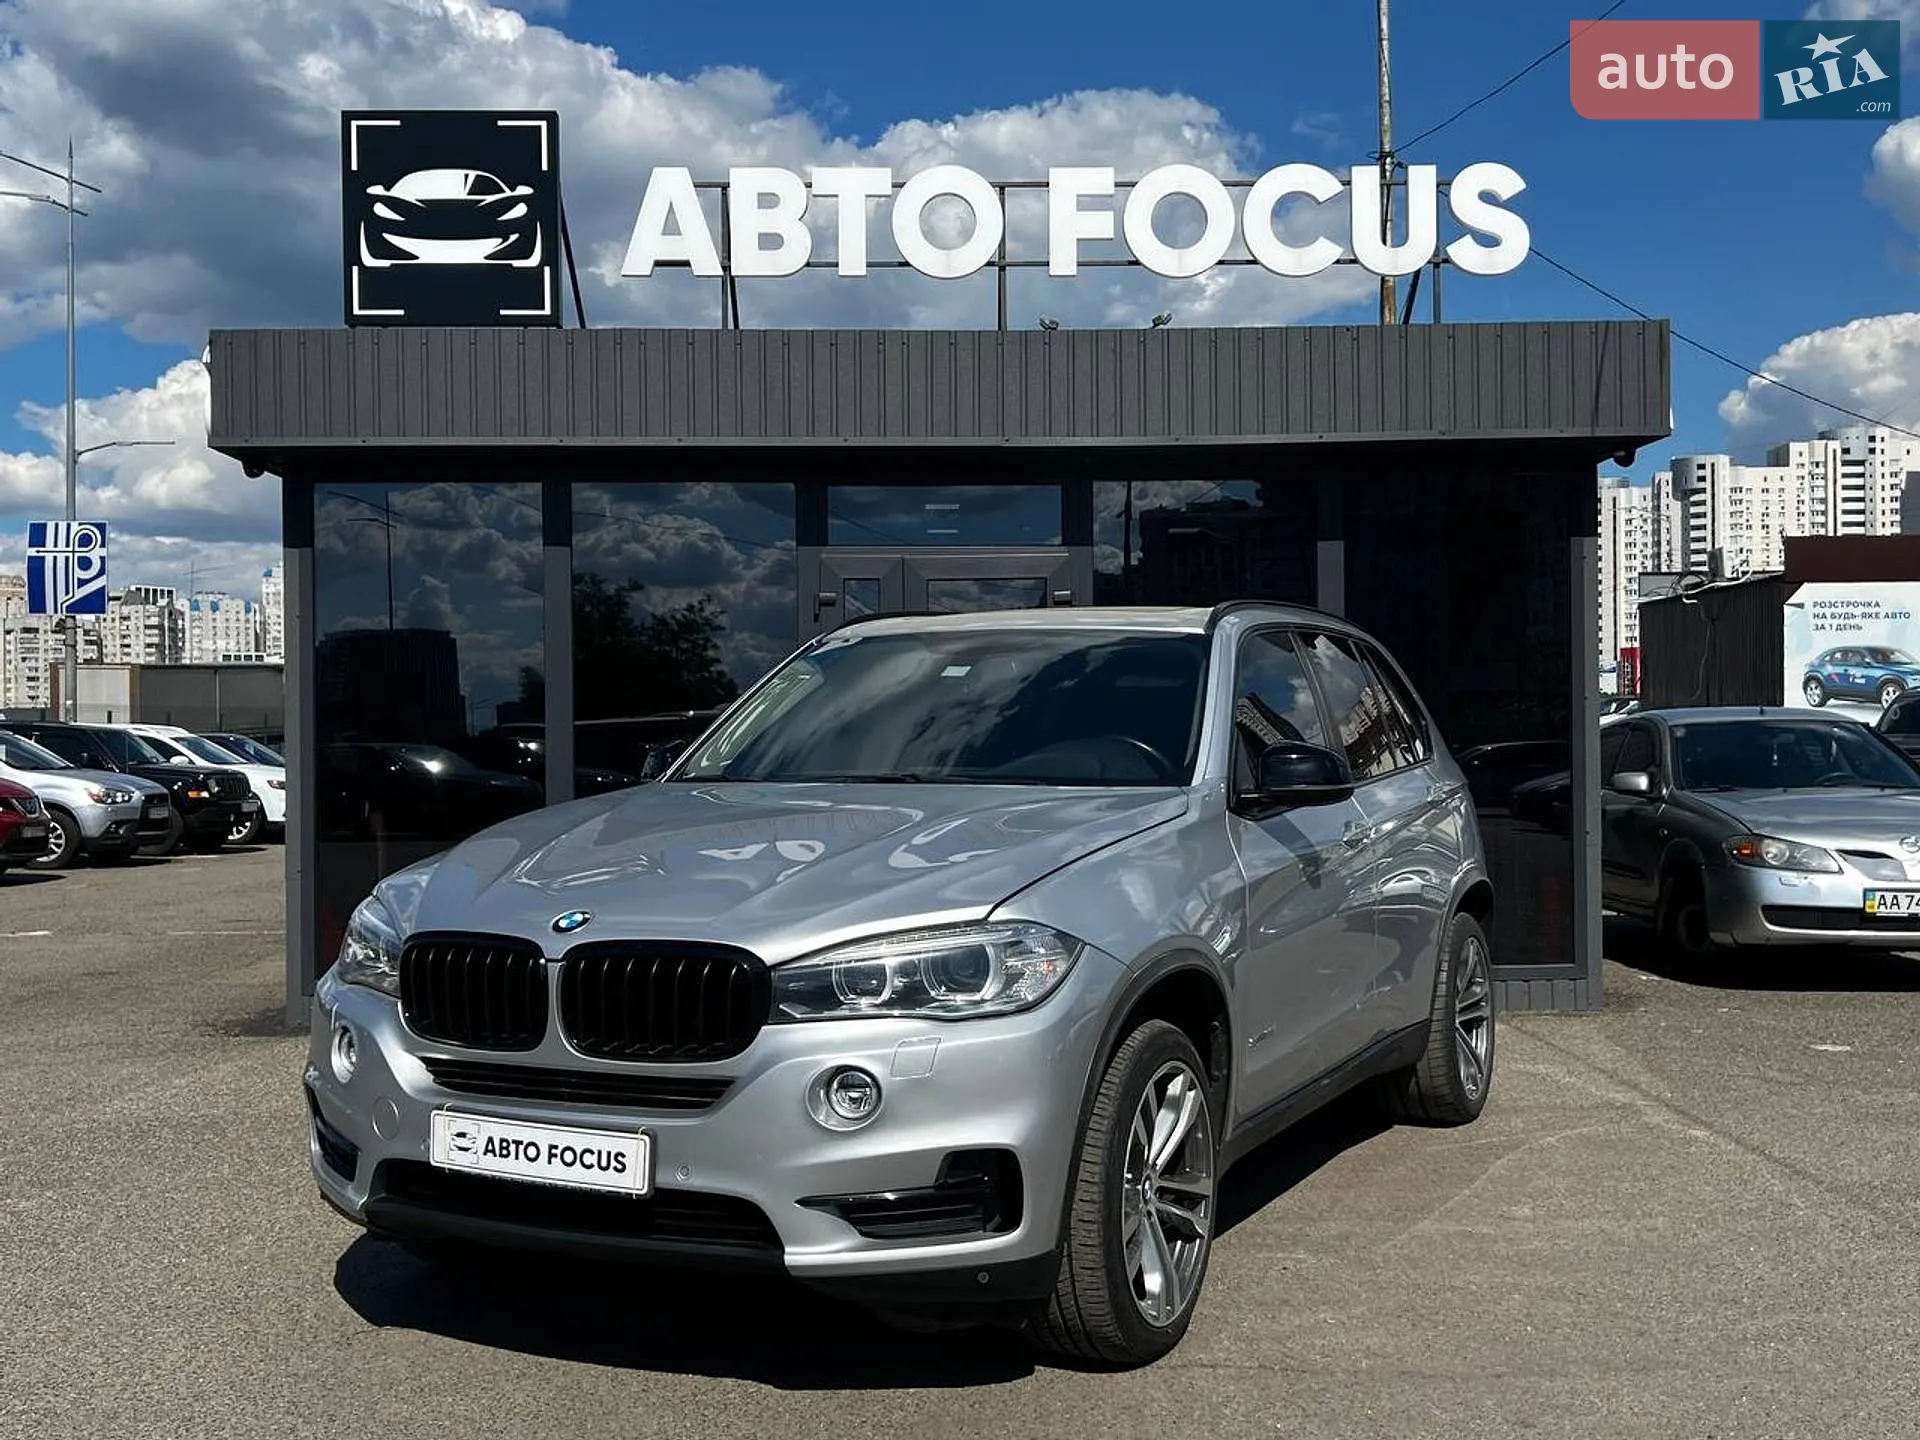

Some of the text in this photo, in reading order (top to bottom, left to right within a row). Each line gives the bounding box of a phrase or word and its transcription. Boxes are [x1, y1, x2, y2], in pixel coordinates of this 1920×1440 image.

[621, 162, 1532, 279] АВТО FOCUS
[1812, 600, 1880, 609] РОЗСТРОЧКА
[1813, 611, 1911, 620] НА БУДЬ-ЯКЕ АВТО
[1813, 623, 1826, 631] ЗА
[1835, 623, 1863, 632] ДЕНЬ
[483, 1135, 628, 1173] АВТО FOCUS
